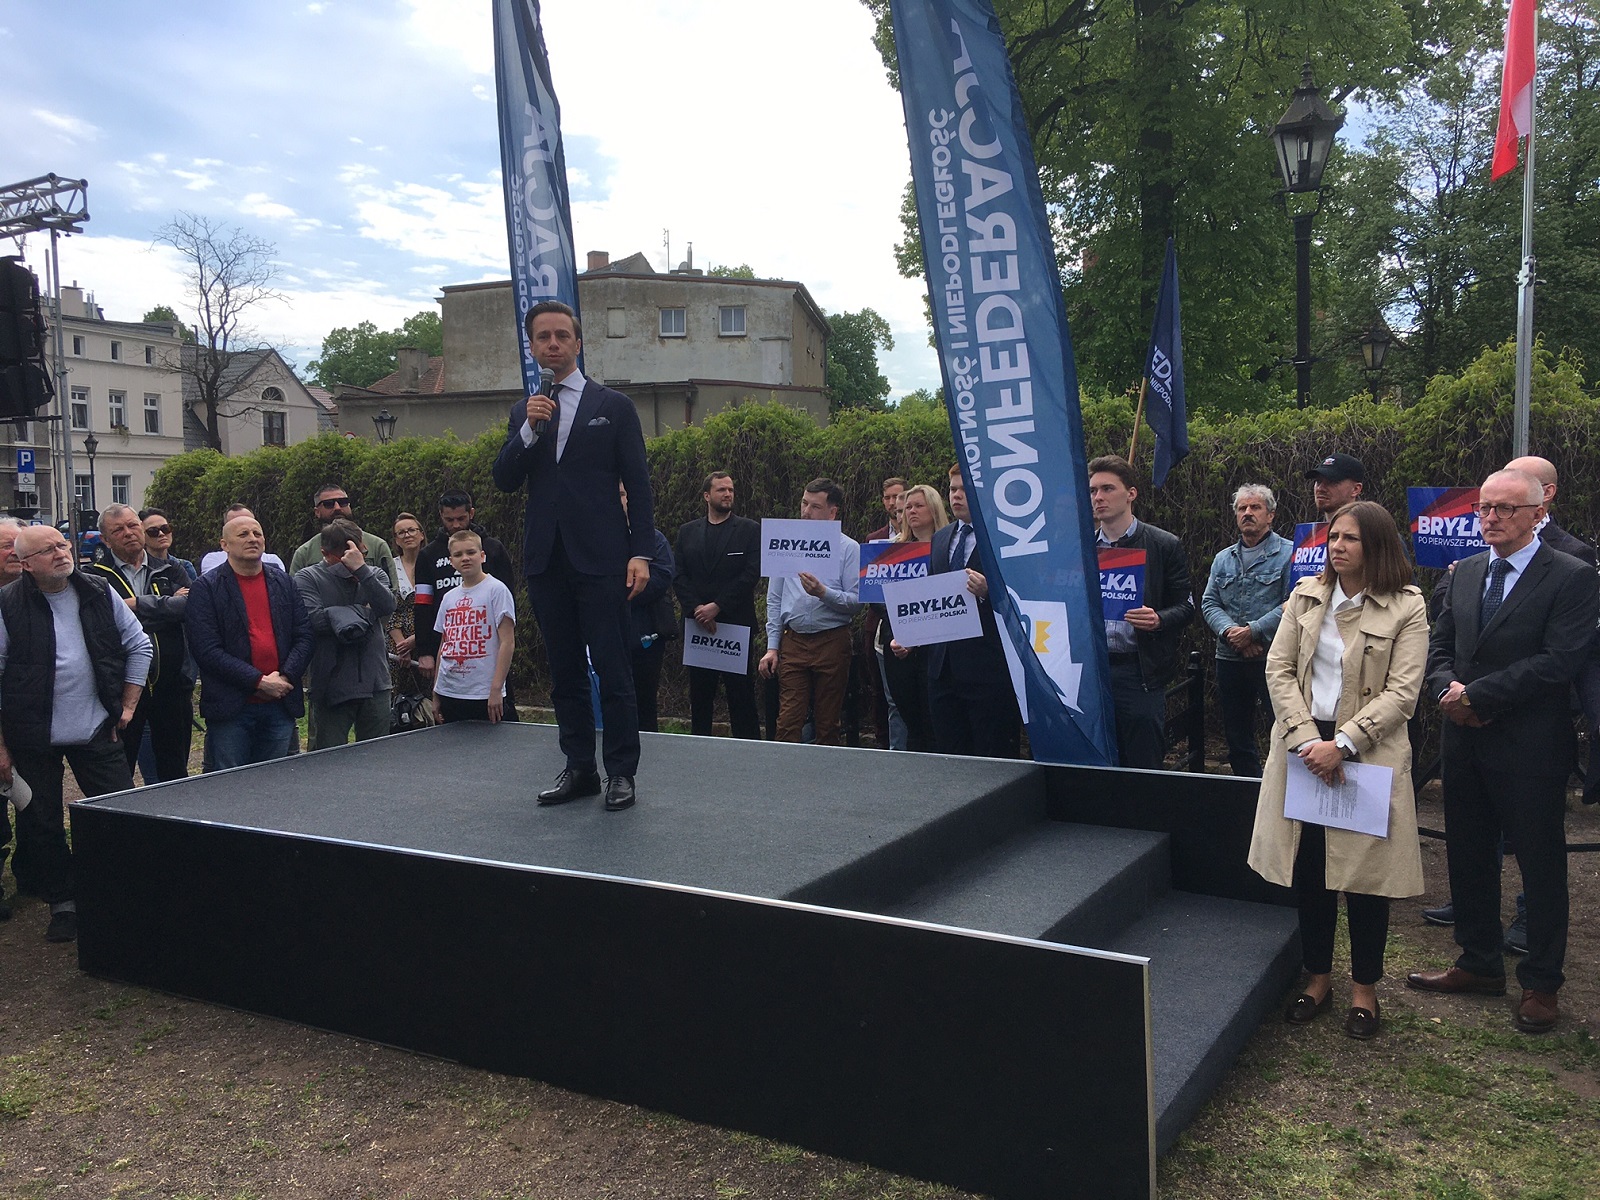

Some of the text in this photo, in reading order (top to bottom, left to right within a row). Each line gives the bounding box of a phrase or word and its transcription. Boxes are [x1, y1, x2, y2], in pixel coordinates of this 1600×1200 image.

[21, 451, 31, 466] P
[769, 539, 831, 552] BRYŁKA
[1418, 536, 1428, 544] PO
[1428, 537, 1465, 547] PIERWSZE
[866, 562, 928, 578] BRYŁKA
[1101, 592, 1136, 601] POLSKA!
[897, 594, 967, 617] BRYŁKA
[445, 610, 487, 627] CZOŁEM
[909, 615, 938, 623] PIERWSZE
[939, 609, 968, 619] POLSKA!
[691, 634, 741, 651] BRYŁKA
